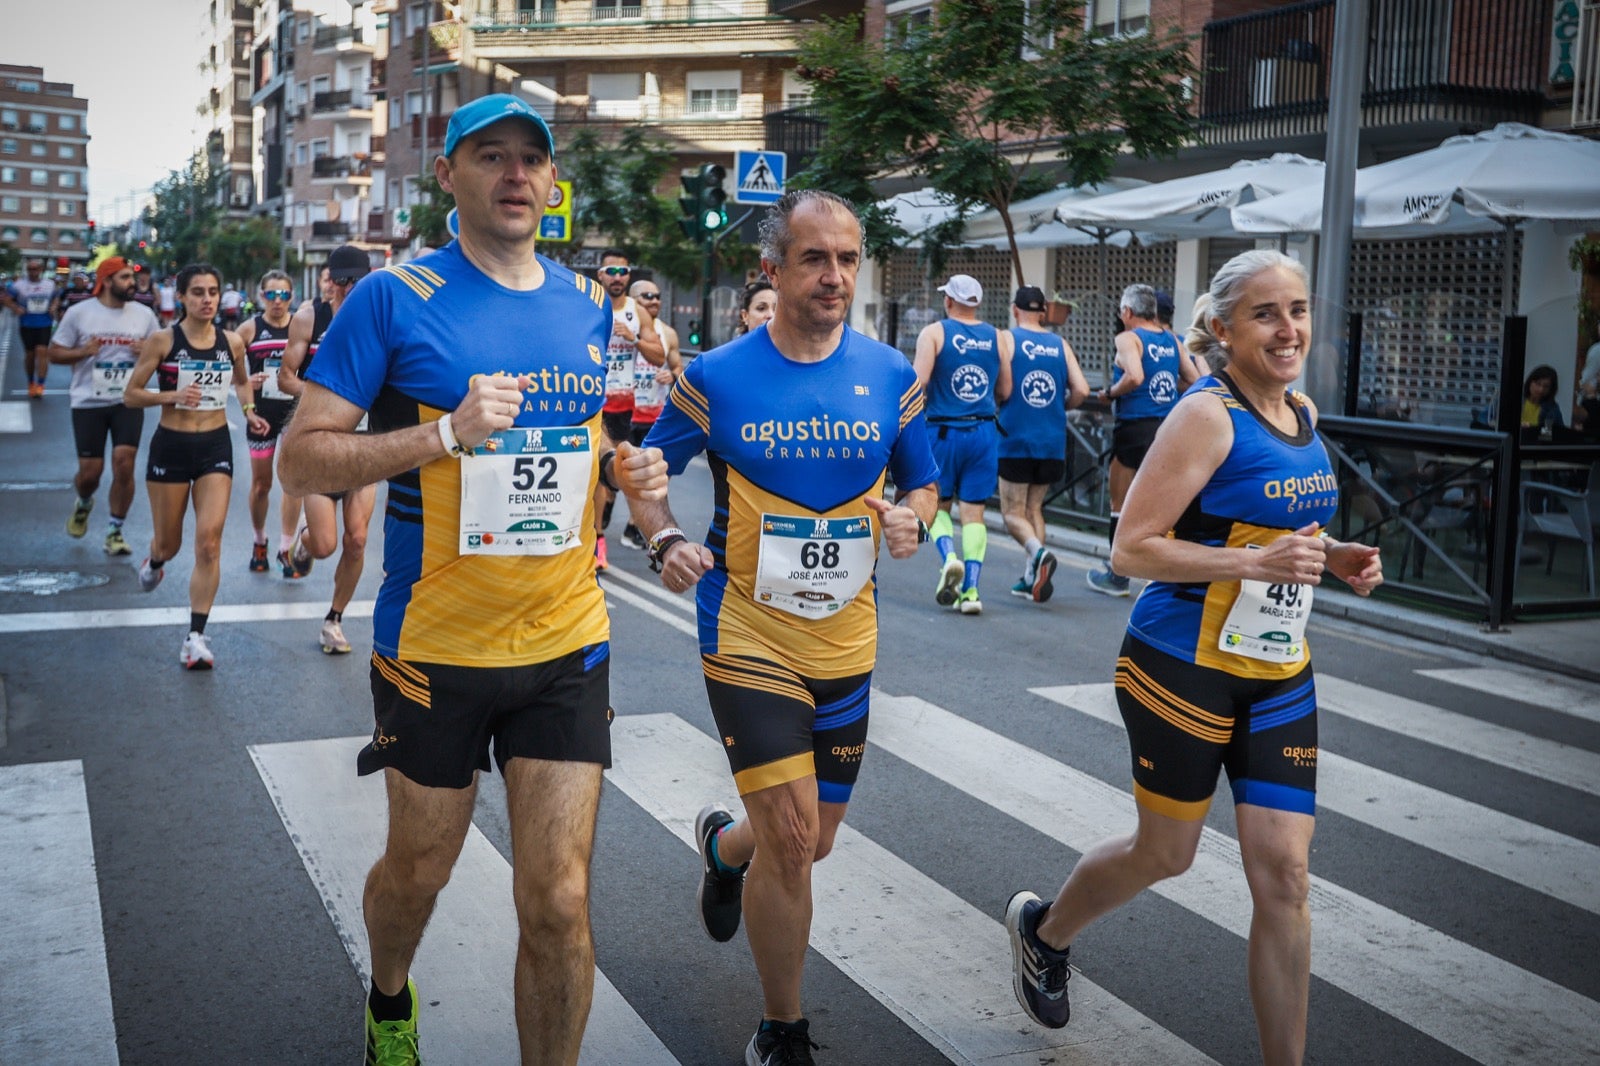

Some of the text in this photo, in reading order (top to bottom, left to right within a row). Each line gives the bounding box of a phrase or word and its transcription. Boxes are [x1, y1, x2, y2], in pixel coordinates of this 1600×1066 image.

[104, 368, 127, 379] 677
[194, 372, 223, 385] 224
[469, 365, 603, 396] stinos
[524, 400, 587, 414] ANADA
[741, 414, 881, 449] agustinos
[765, 447, 866, 459] GRANADA
[512, 457, 558, 491] 52
[508, 493, 562, 505] FERNANDO
[1287, 496, 1338, 513] GRANAD
[800, 541, 841, 569] 68
[788, 570, 849, 580] JOSÉ ANTONIO
